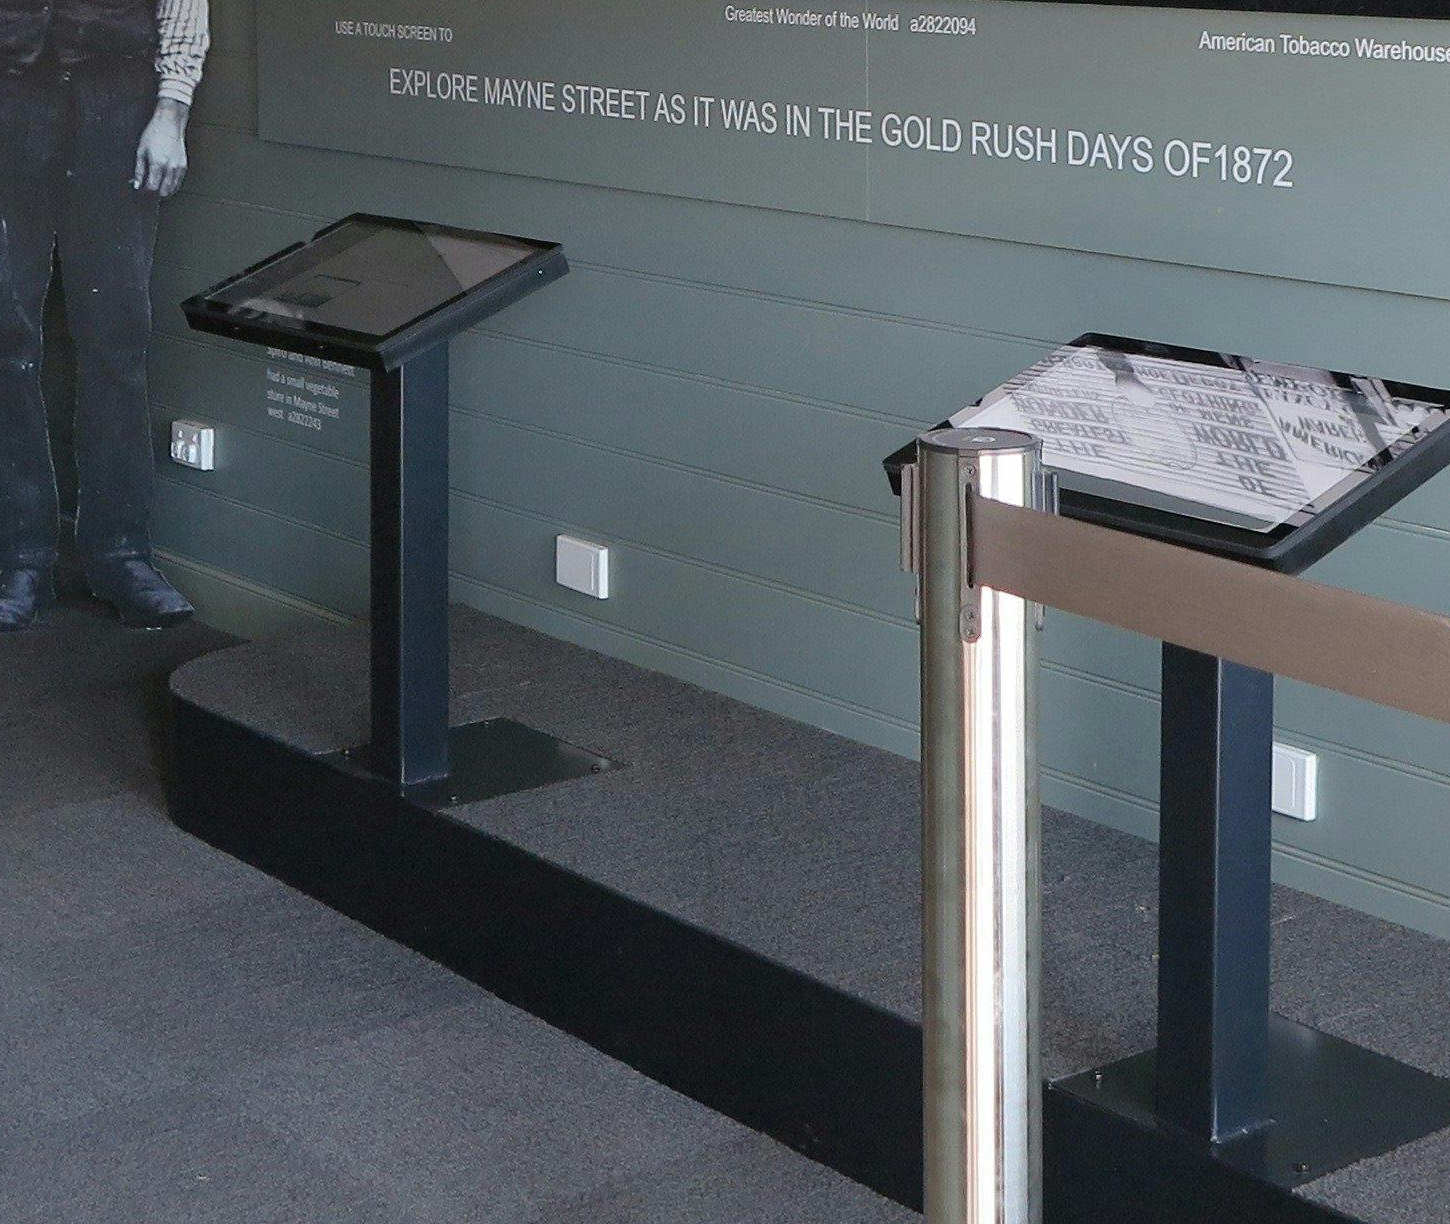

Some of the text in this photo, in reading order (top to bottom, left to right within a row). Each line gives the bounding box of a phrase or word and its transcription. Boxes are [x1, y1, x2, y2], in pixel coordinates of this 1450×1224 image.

[335, 21, 354, 35] USE
[363, 22, 395, 38] TOUCH
[397, 25, 437, 41] SCREEN
[439, 27, 453, 42] TO
[725, 4, 976, 35] Greatest Wonder of the World a2822094
[1198, 30, 1275, 54] American
[1279, 33, 1350, 58] Tobacco
[390, 68, 479, 103] EXPLORE
[484, 77, 556, 111] MAYNE
[561, 84, 650, 120] STREET
[654, 93, 686, 125] AS
[694, 96, 714, 128] IT
[720, 99, 777, 134] WAS
[785, 104, 812, 138] IN
[817, 107, 873, 144] THE
[881, 113, 962, 153] GOLD
[970, 121, 1057, 164] RUSH
[1067, 130, 1153, 173] DAYS
